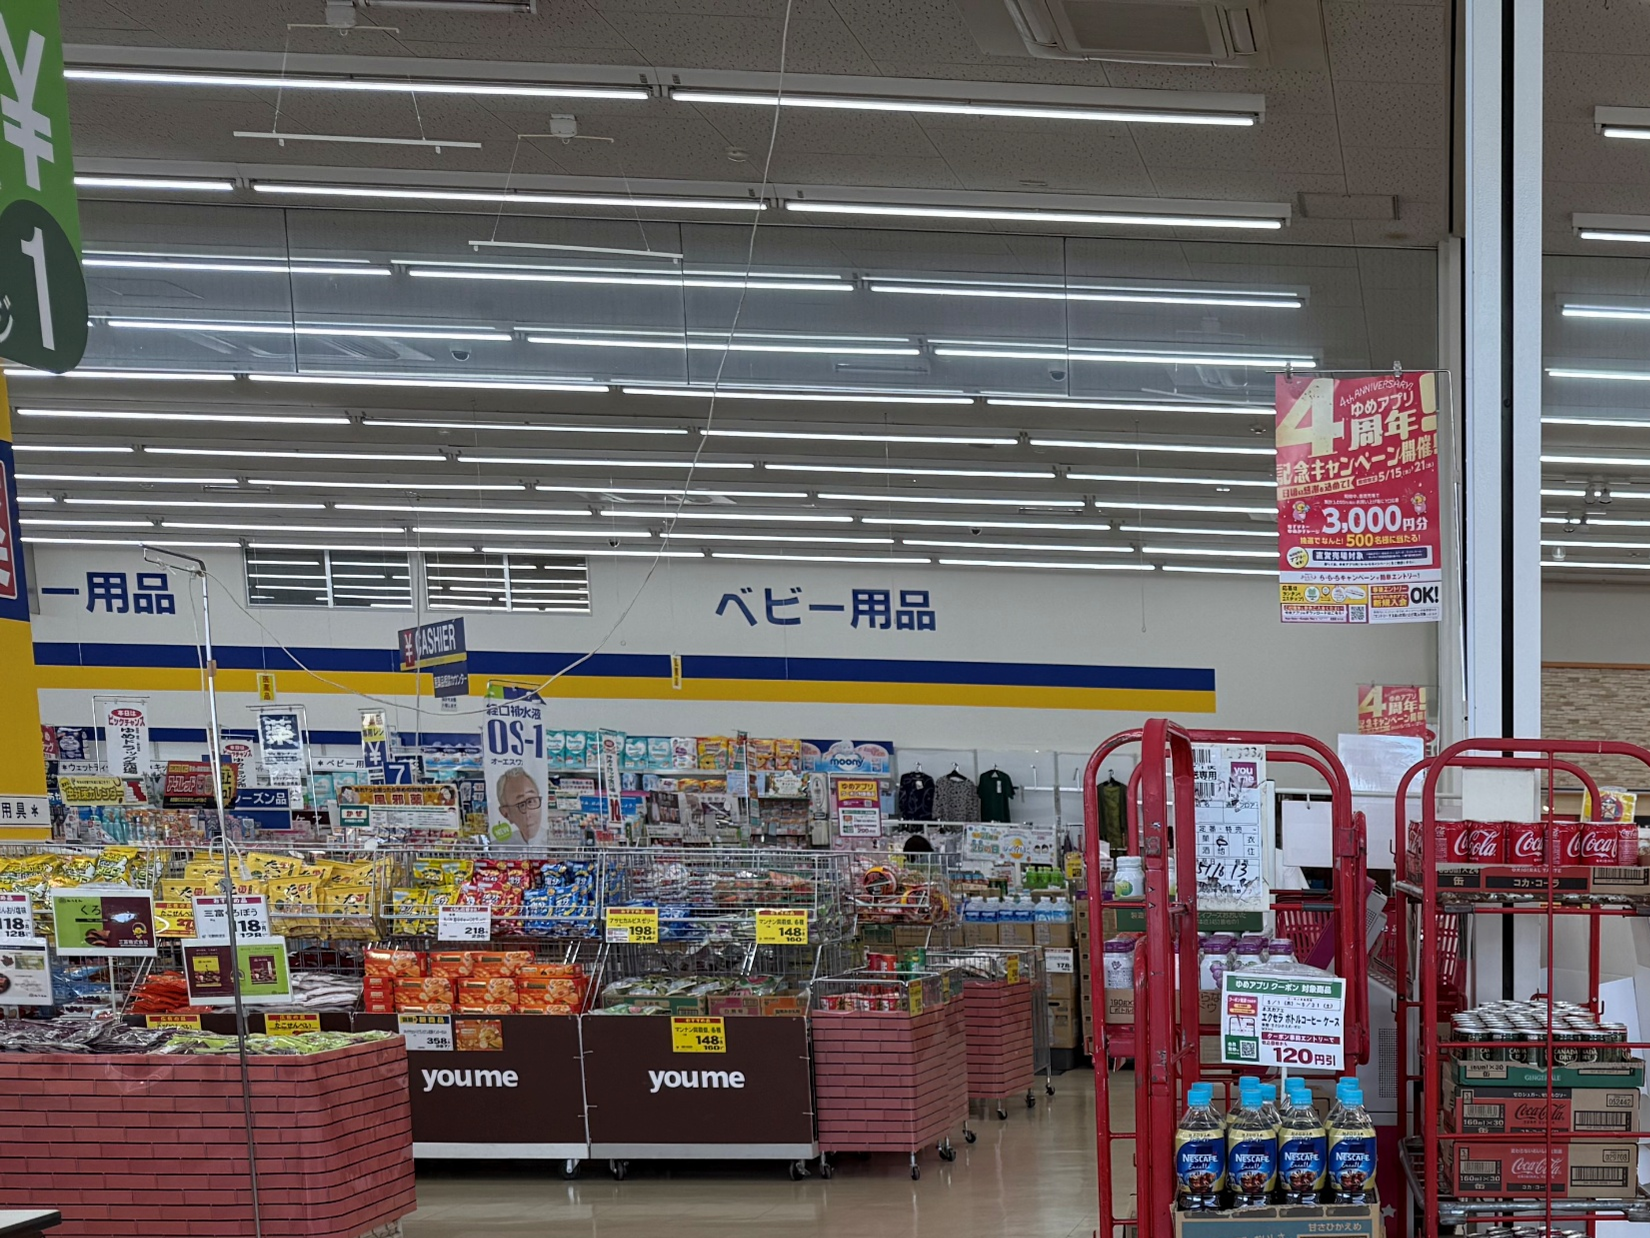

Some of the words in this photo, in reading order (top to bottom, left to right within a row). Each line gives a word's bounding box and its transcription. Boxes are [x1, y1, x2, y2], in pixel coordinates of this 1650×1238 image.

[1351, 390, 1414, 416] ゆめアプリ
[1276, 434, 1438, 486] 記念キャンペーン開催!
[1322, 504, 1428, 535] 3,000円分
[1410, 586, 1439, 605] OK!
[715, 586, 937, 632] ベビー用品
[414, 624, 457, 657] CASHIER
[261, 675, 271, 701] 医薬品
[486, 703, 541, 720] 経口補水液
[487, 719, 544, 759] OS-1
[829, 754, 866, 768] moony
[1513, 878, 1560, 888] コカ・コーラ
[628, 926, 652, 936] 198
[779, 927, 801, 937] 148
[1235, 980, 1269, 990] ゆめアプリ
[1271, 982, 1299, 991] クーポン
[1261, 1013, 1283, 1023] エクセラ
[1285, 1014, 1322, 1026] ボトルコーヒー
[1324, 1017, 1340, 1027] ケース
[696, 1035, 719, 1046] 148
[1273, 1047, 1336, 1066] 120円引
[422, 1068, 519, 1092] youme
[648, 1068, 746, 1093] youme
[1308, 1222, 1362, 1232] 甘さひかえめ
